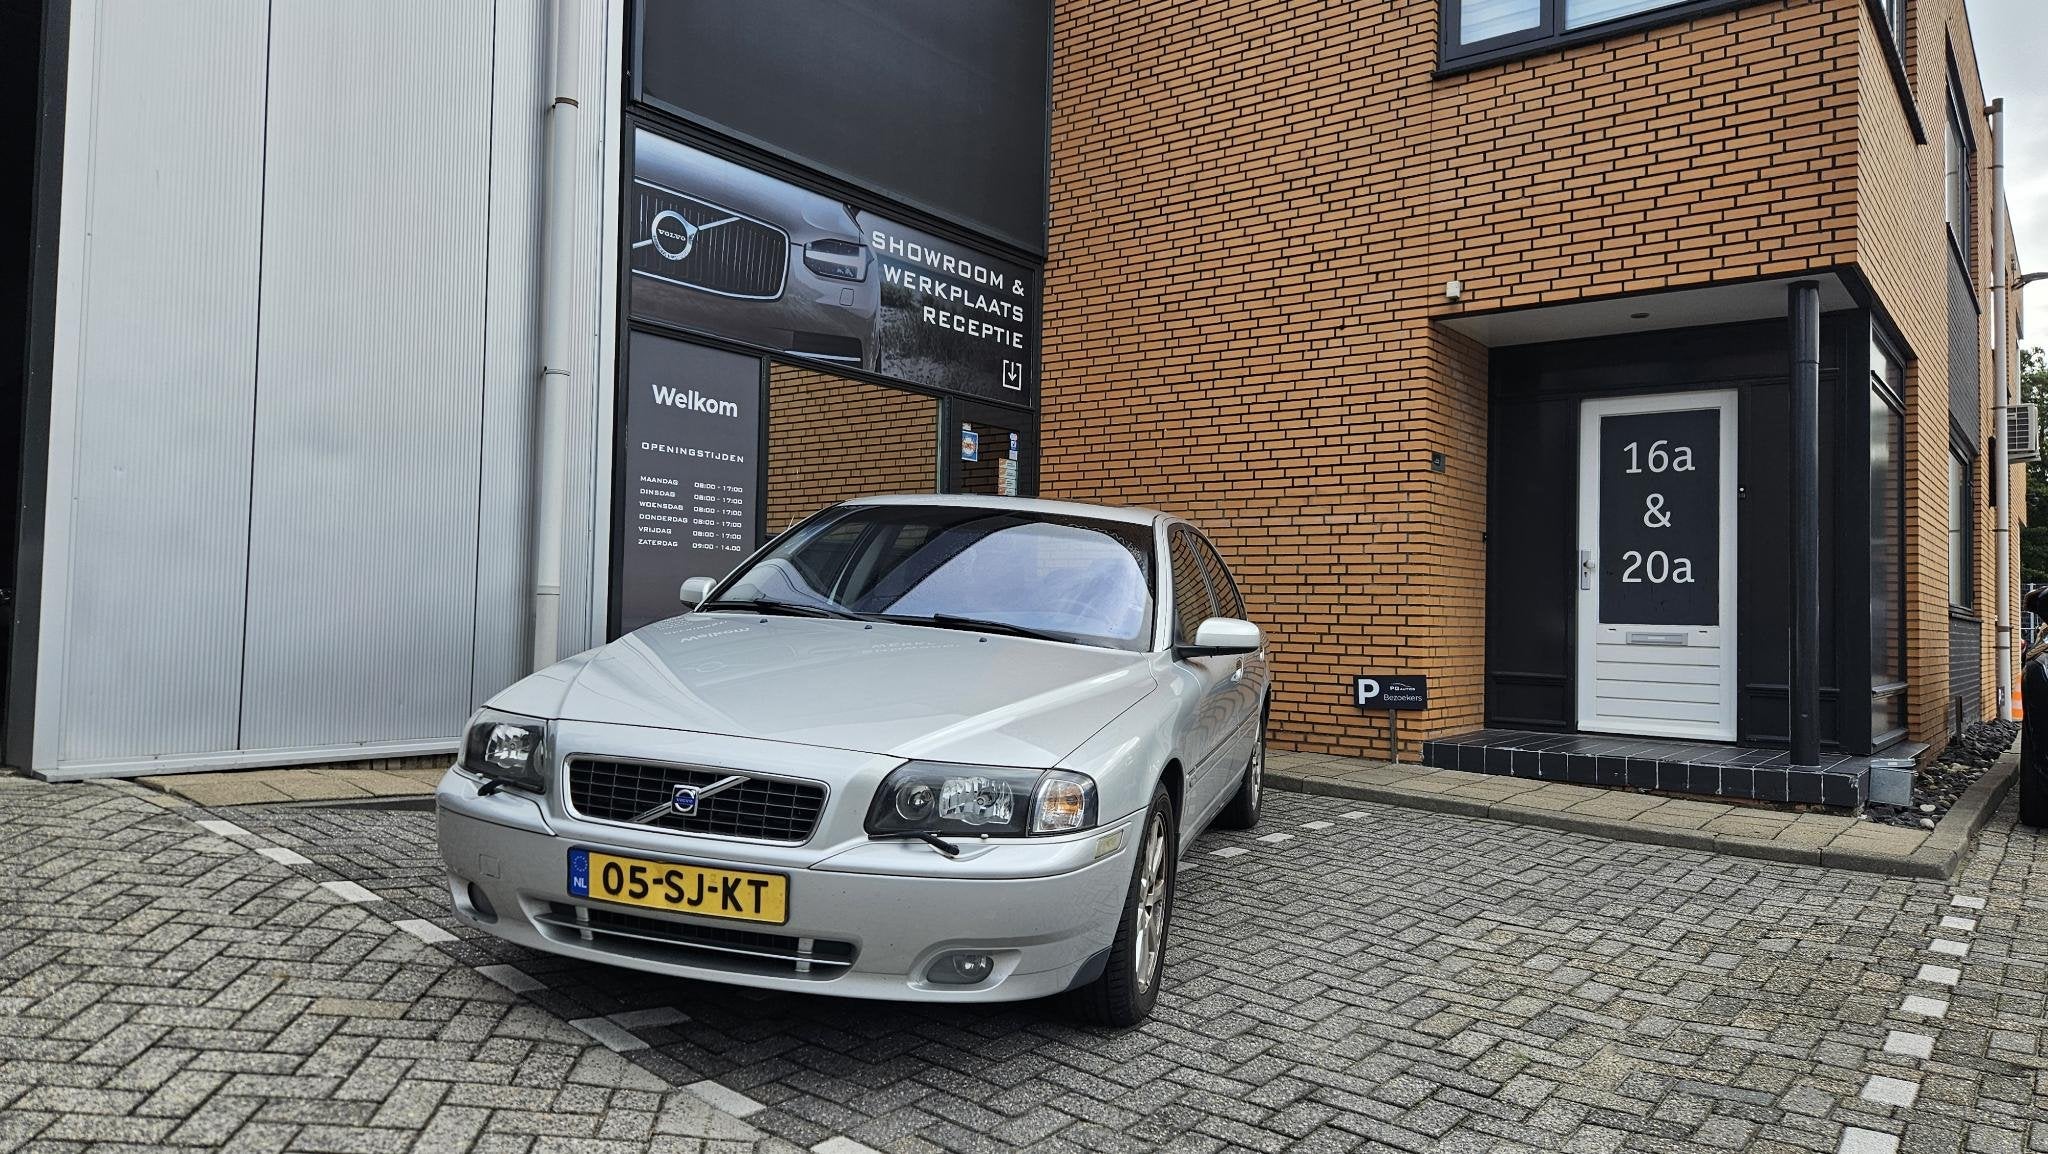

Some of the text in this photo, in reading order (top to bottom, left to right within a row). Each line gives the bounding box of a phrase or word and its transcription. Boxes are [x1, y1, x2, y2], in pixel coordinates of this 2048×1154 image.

[657, 228, 686, 242] VOLVO
[871, 230, 1025, 297] SHOWROOM &
[883, 263, 1024, 323] WERKPLAATS
[923, 306, 1023, 349] RECEPTIE
[652, 384, 738, 418] Welkom
[641, 441, 744, 463] OPENINGSTIJDEN
[1623, 439, 1696, 474] 16a
[640, 475, 679, 486] MAANDAG
[640, 488, 676, 498] DINSDAG
[639, 501, 684, 511] WOENSDAG
[1643, 493, 1672, 528] &
[639, 513, 688, 524] DONDERDAG
[638, 526, 672, 535] VRIJDAG
[638, 538, 678, 547] ZATERDAG
[1622, 550, 1695, 584] 20a
[1358, 679, 1380, 704] P
[1383, 694, 1423, 702] Bezoekers
[573, 876, 587, 889] NL
[602, 861, 769, 914] 05-SJ-KT
